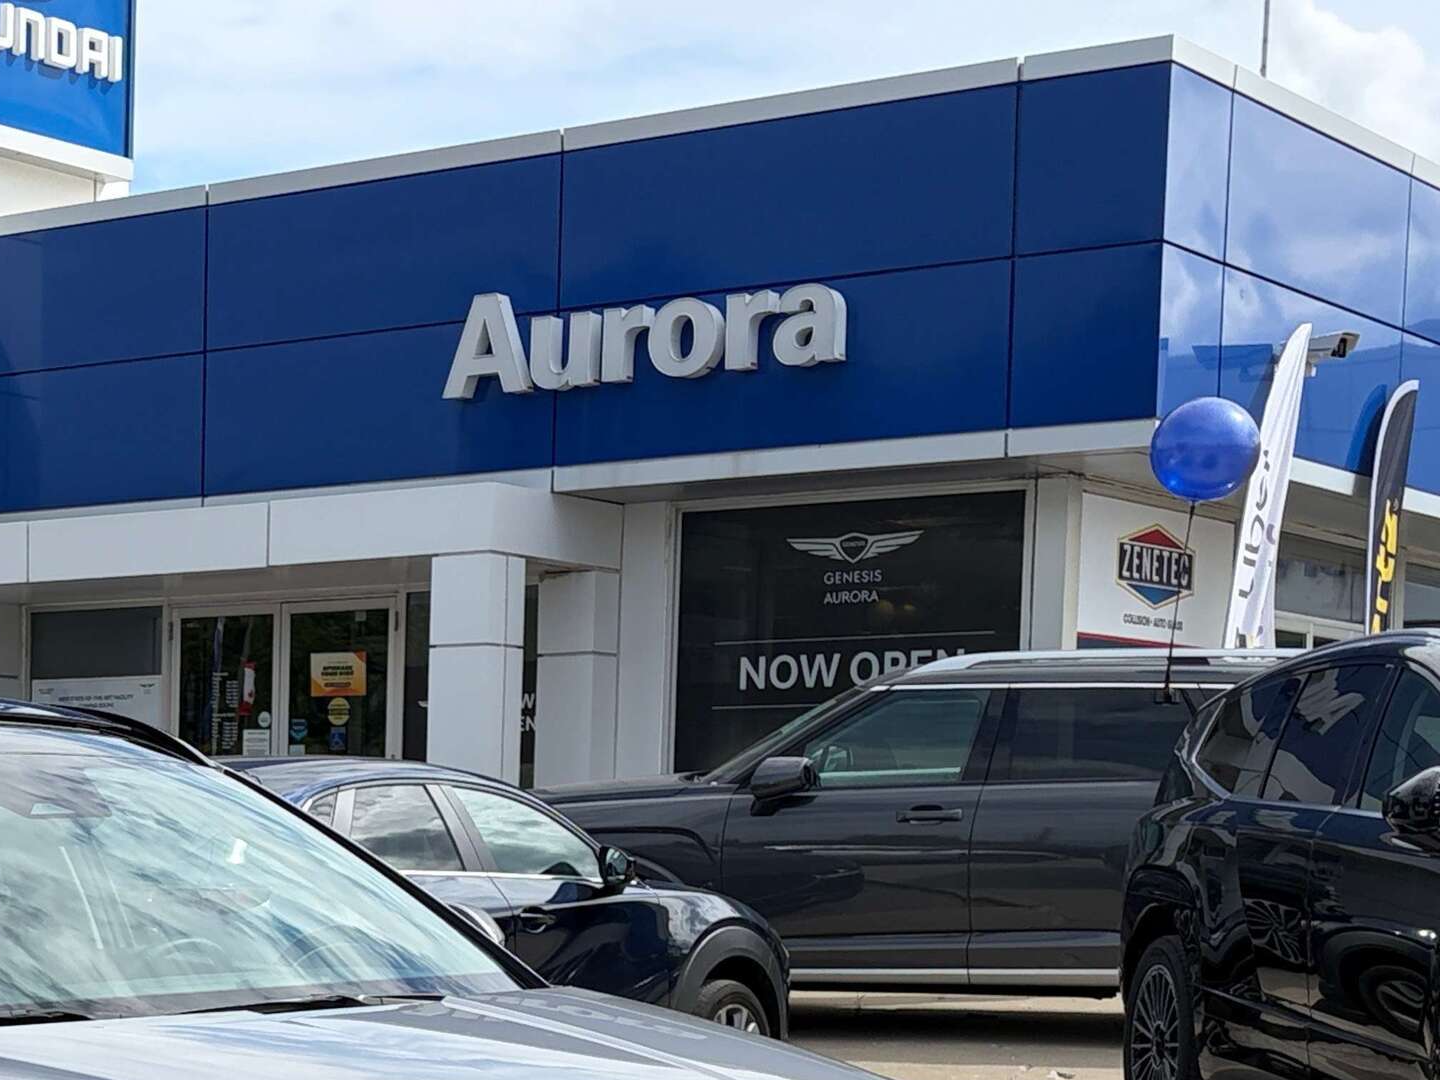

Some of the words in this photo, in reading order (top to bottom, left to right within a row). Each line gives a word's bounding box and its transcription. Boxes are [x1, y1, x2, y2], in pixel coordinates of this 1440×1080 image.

[442, 282, 848, 400] Aurora
[823, 569, 883, 585] GENESIS
[1121, 543, 1190, 587] ZENETEC
[823, 589, 880, 605] AURORA
[739, 652, 841, 692] NOW
[849, 647, 966, 688] OP
